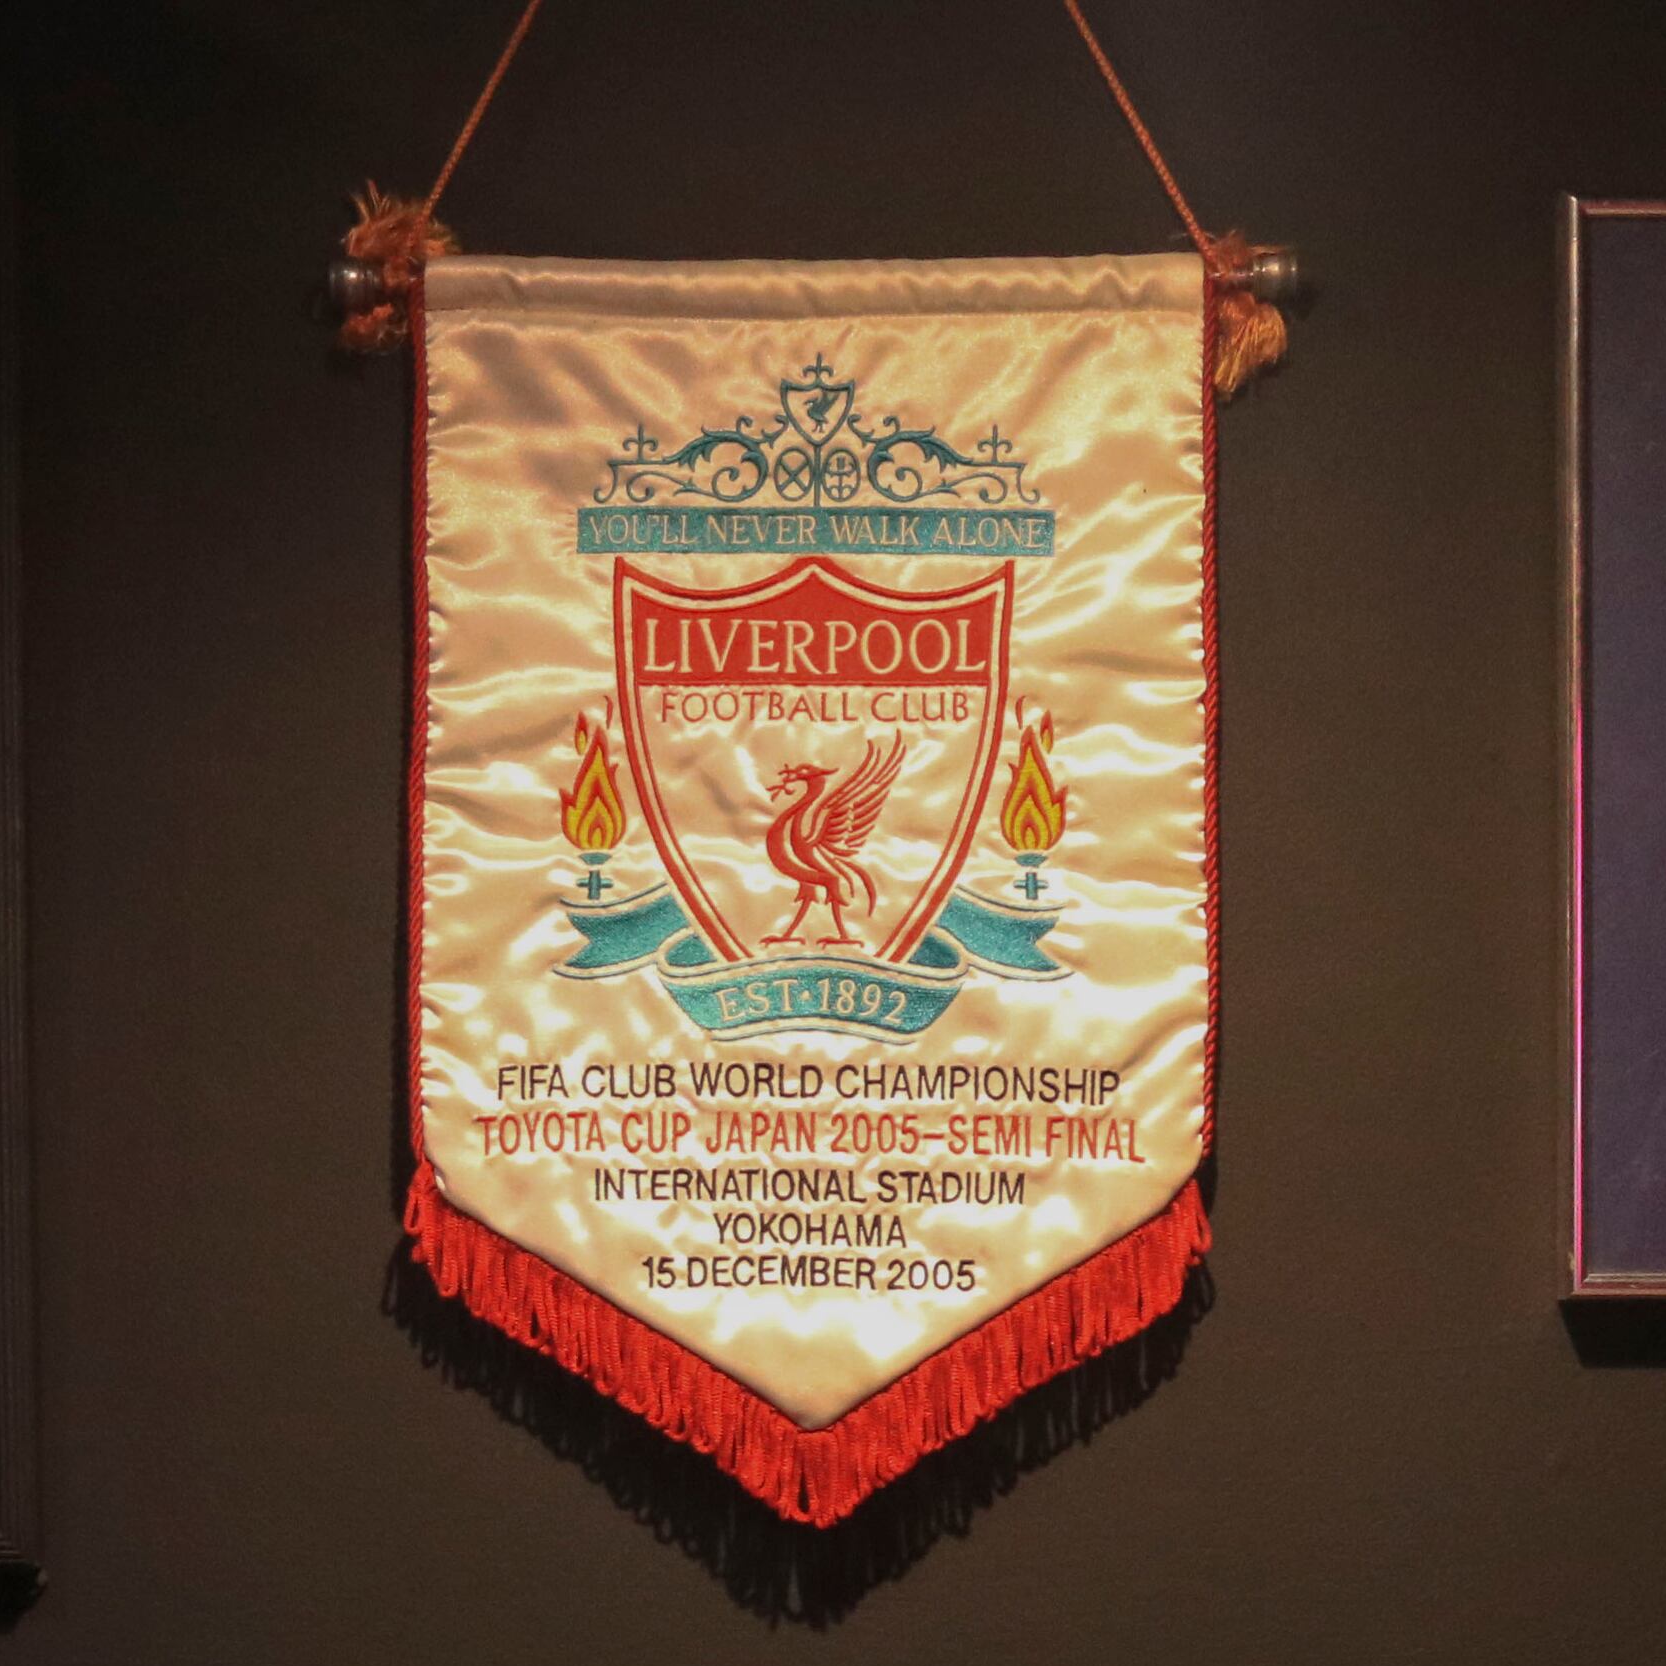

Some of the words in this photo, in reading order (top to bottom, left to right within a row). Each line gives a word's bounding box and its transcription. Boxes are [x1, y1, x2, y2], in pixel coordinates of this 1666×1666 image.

[590, 517, 697, 549] YOU'LL
[705, 516, 817, 547] NEVER
[828, 516, 921, 547] WALK
[933, 516, 1050, 549] ALONE
[641, 617, 988, 676] LIVERPOOL
[659, 690, 859, 724] FOOTBALL
[870, 689, 971, 724] CLUB
[496, 1065, 570, 1101] FIFA
[580, 1063, 678, 1099] CLUB
[688, 1062, 824, 1100] WORLD
[835, 1065, 1122, 1107] CHAMPIONSHIP
[476, 1112, 606, 1157] TOYOTA
[620, 1111, 692, 1155] CUP
[705, 1111, 817, 1155] JAPAN
[1044, 1115, 1146, 1164] FINAL
[594, 1168, 868, 1205] INTERNATIONAL
[877, 1169, 1027, 1206] STADIUM
[713, 1211, 908, 1249] YOKOHAMA
[642, 1257, 677, 1291] 15
[687, 1258, 878, 1291] DECEMBER
[886, 1260, 978, 1292] 2005
